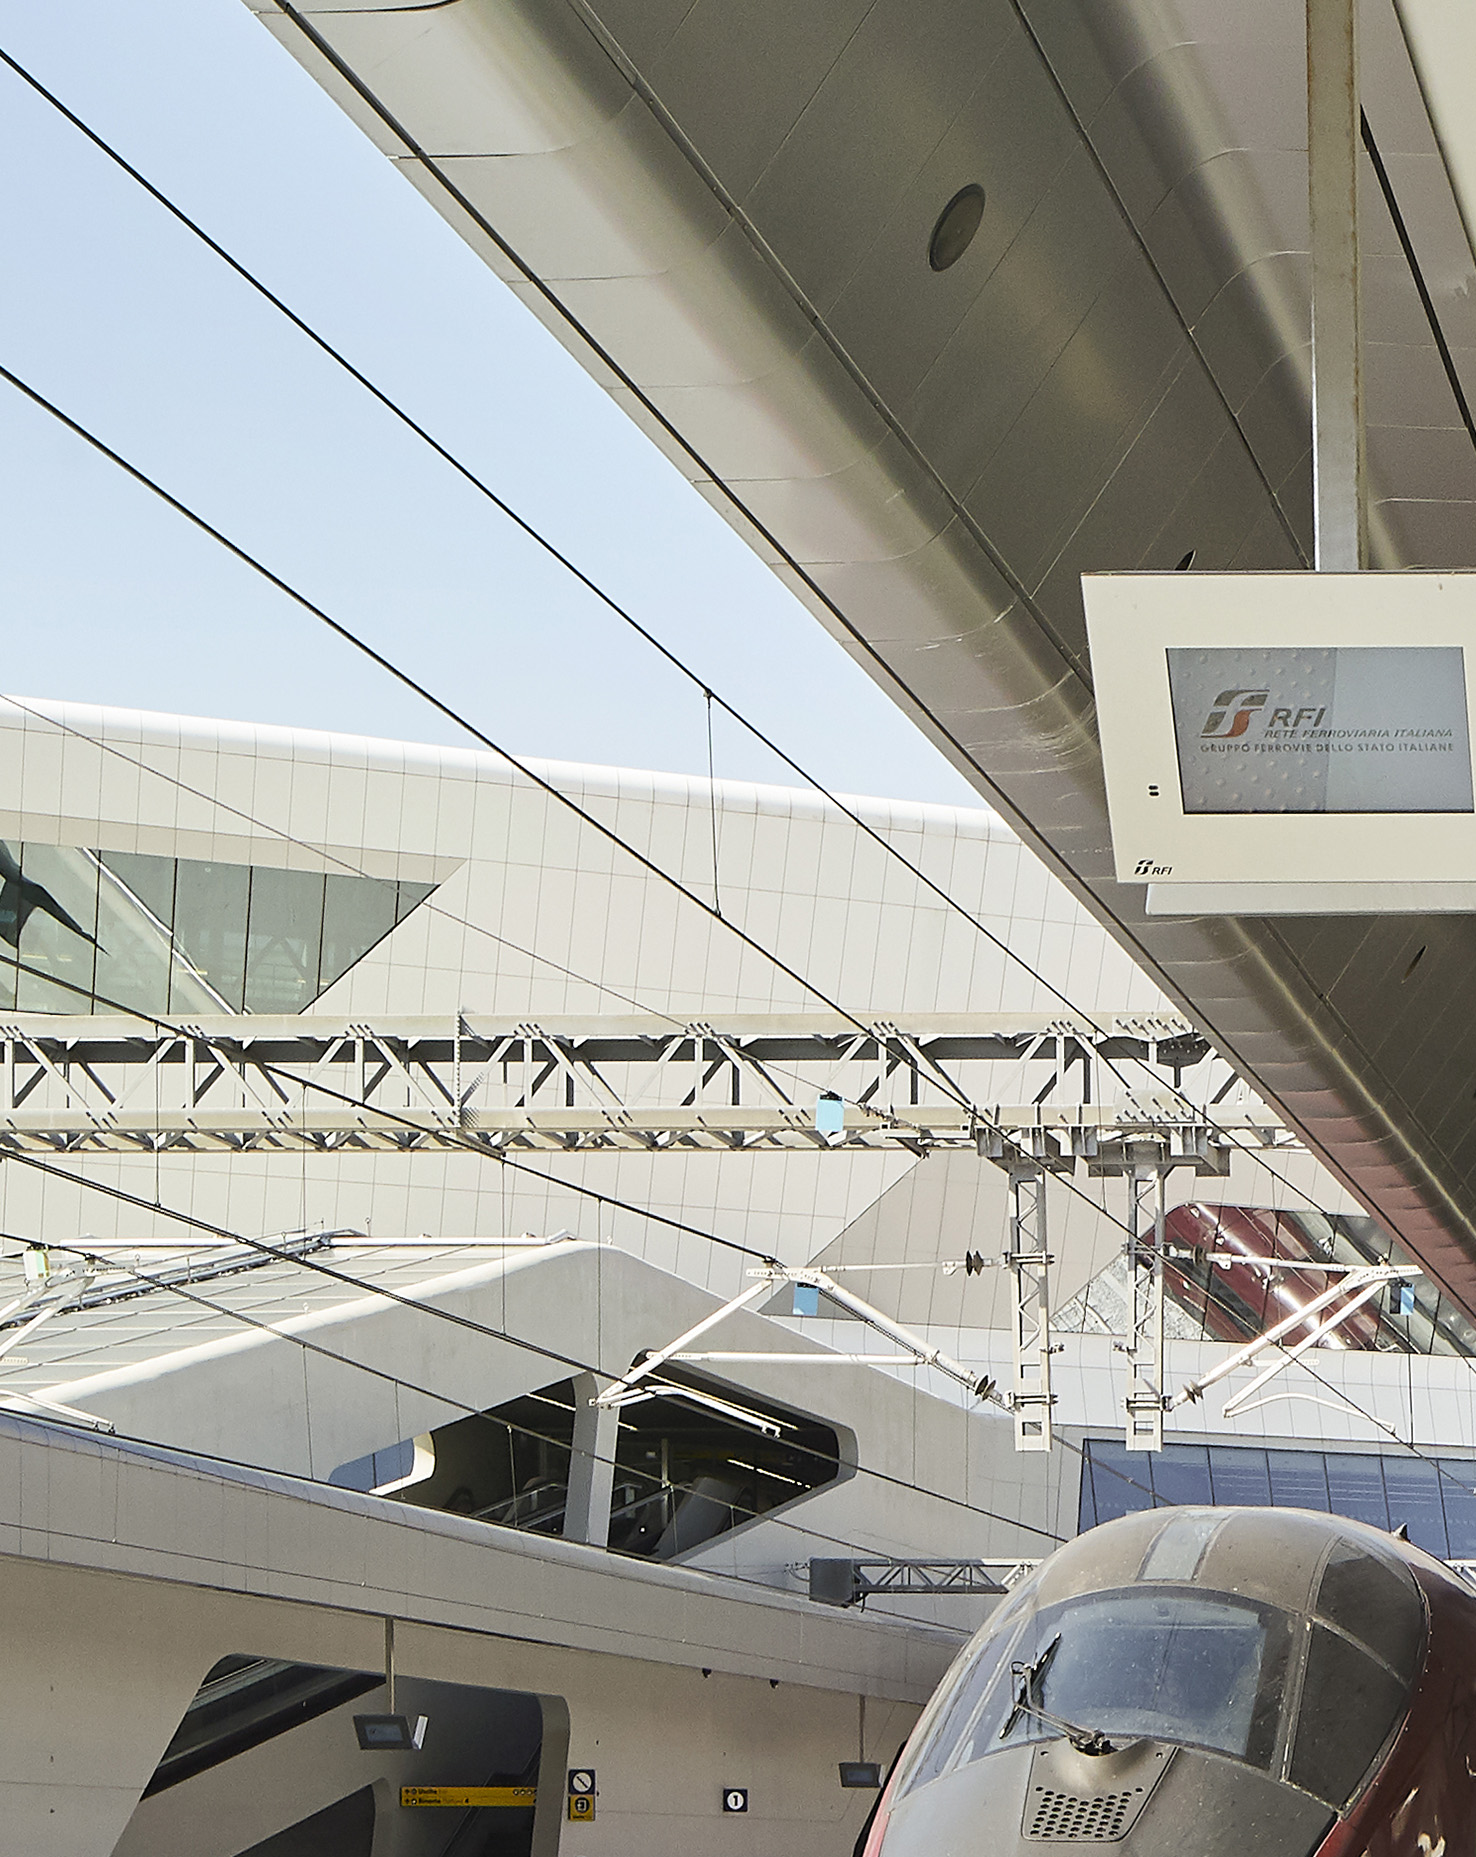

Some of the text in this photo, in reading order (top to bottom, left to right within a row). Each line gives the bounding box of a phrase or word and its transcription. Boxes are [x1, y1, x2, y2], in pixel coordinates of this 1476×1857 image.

[1268, 707, 1327, 728] RFI
[1264, 729, 1453, 739] RETE FERROVIARIA ITALIANA
[1201, 742, 1454, 752] GRUPPO FERROVIE DELLO STATO ITALIANE
[1151, 866, 1173, 875] RFI
[732, 1794, 739, 1807] 1
